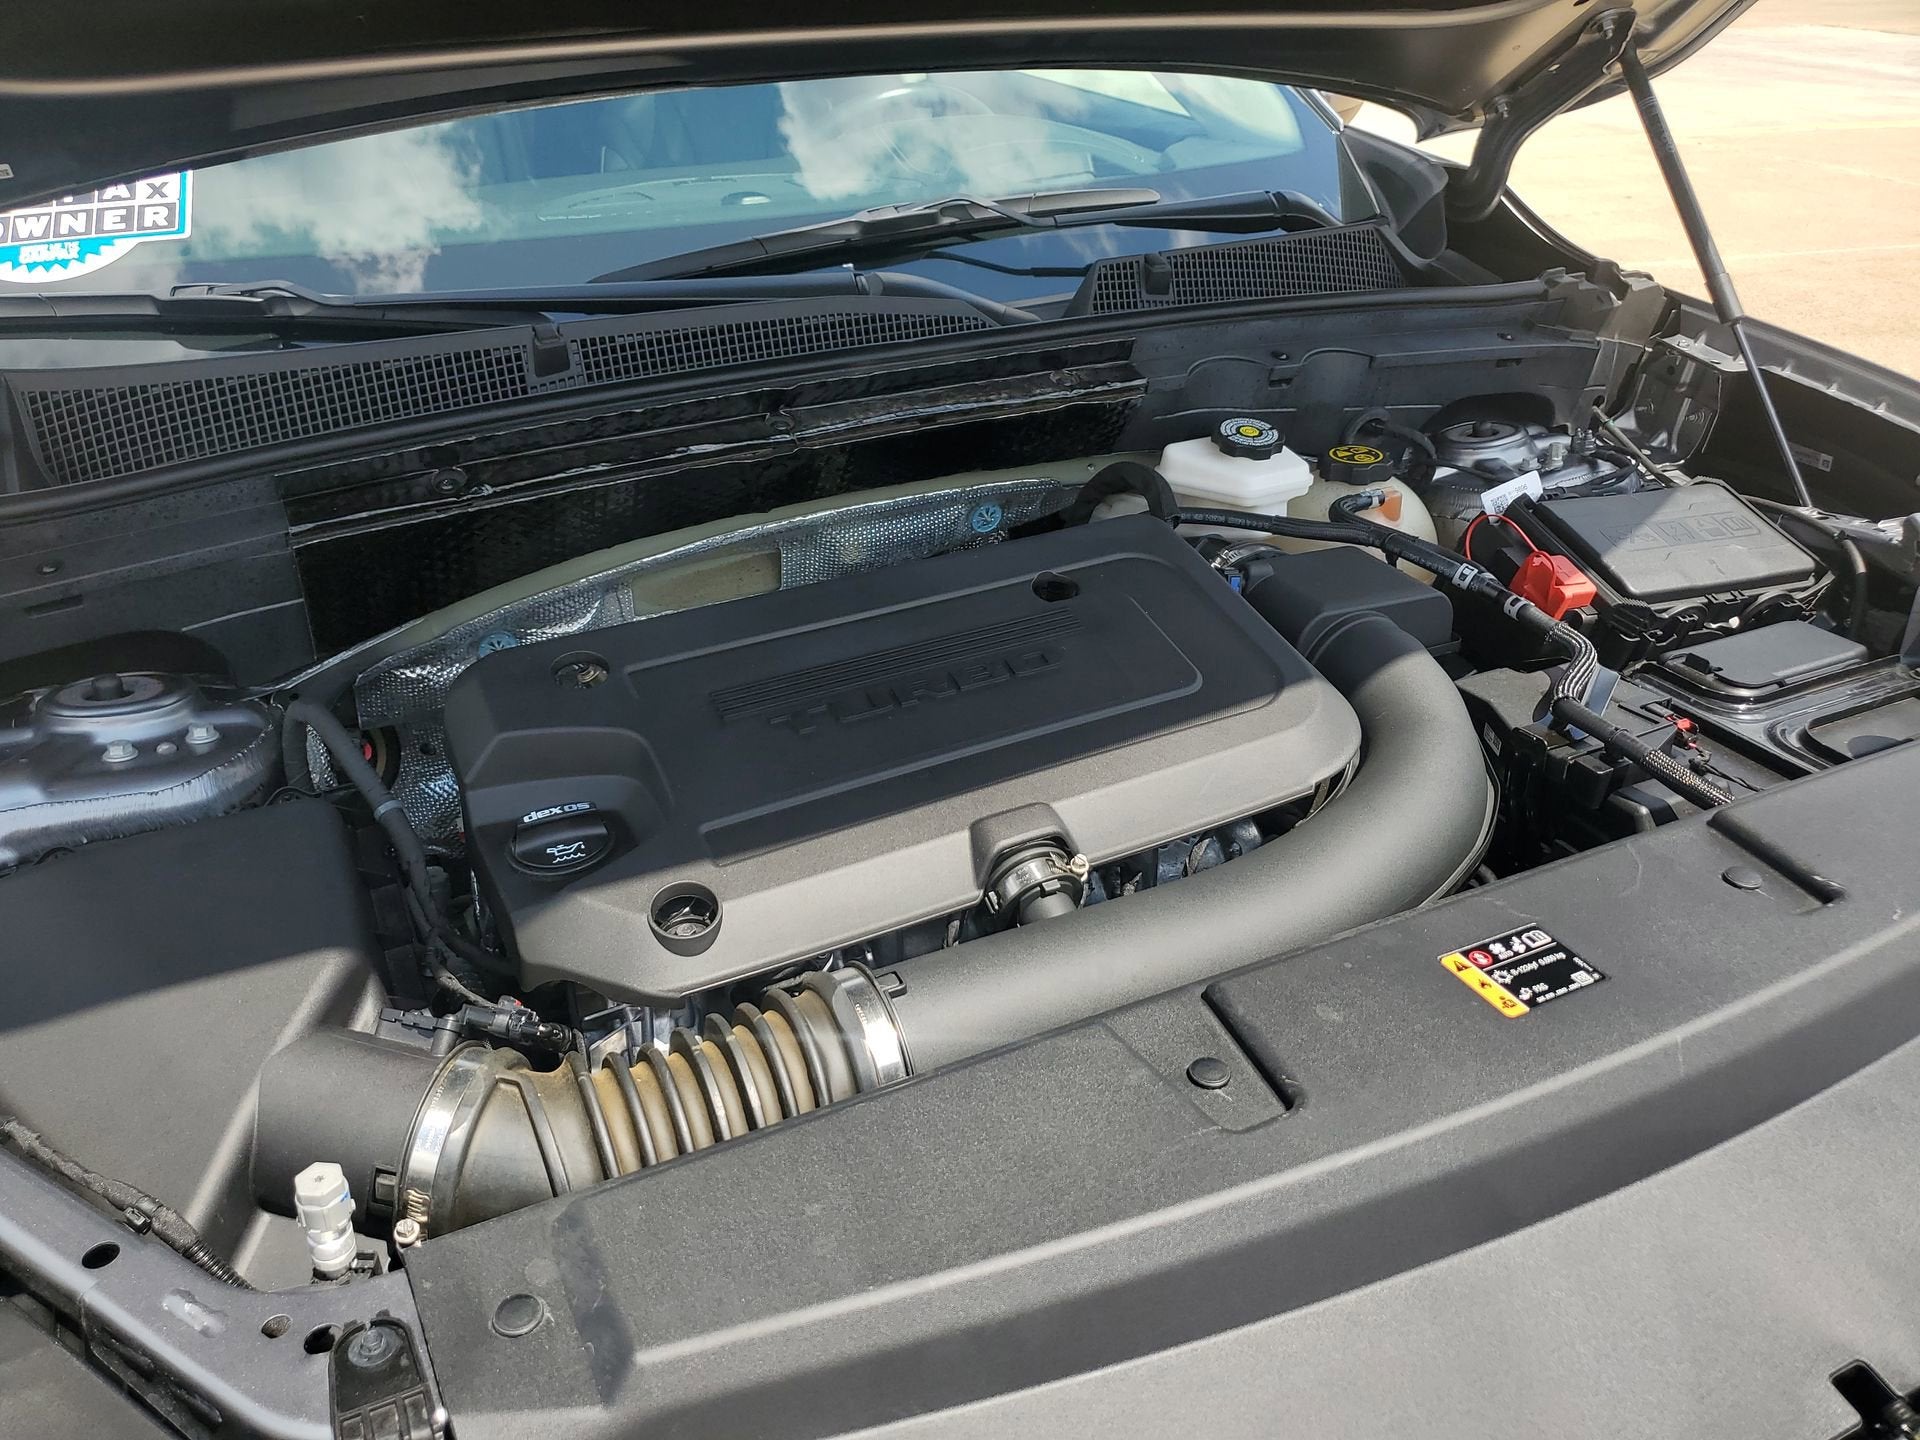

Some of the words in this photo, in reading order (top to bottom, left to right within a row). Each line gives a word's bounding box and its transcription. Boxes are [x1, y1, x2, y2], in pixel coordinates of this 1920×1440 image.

[0, 205, 169, 239] WNER
[768, 651, 1061, 736] TURBO
[523, 802, 590, 823] dexos
